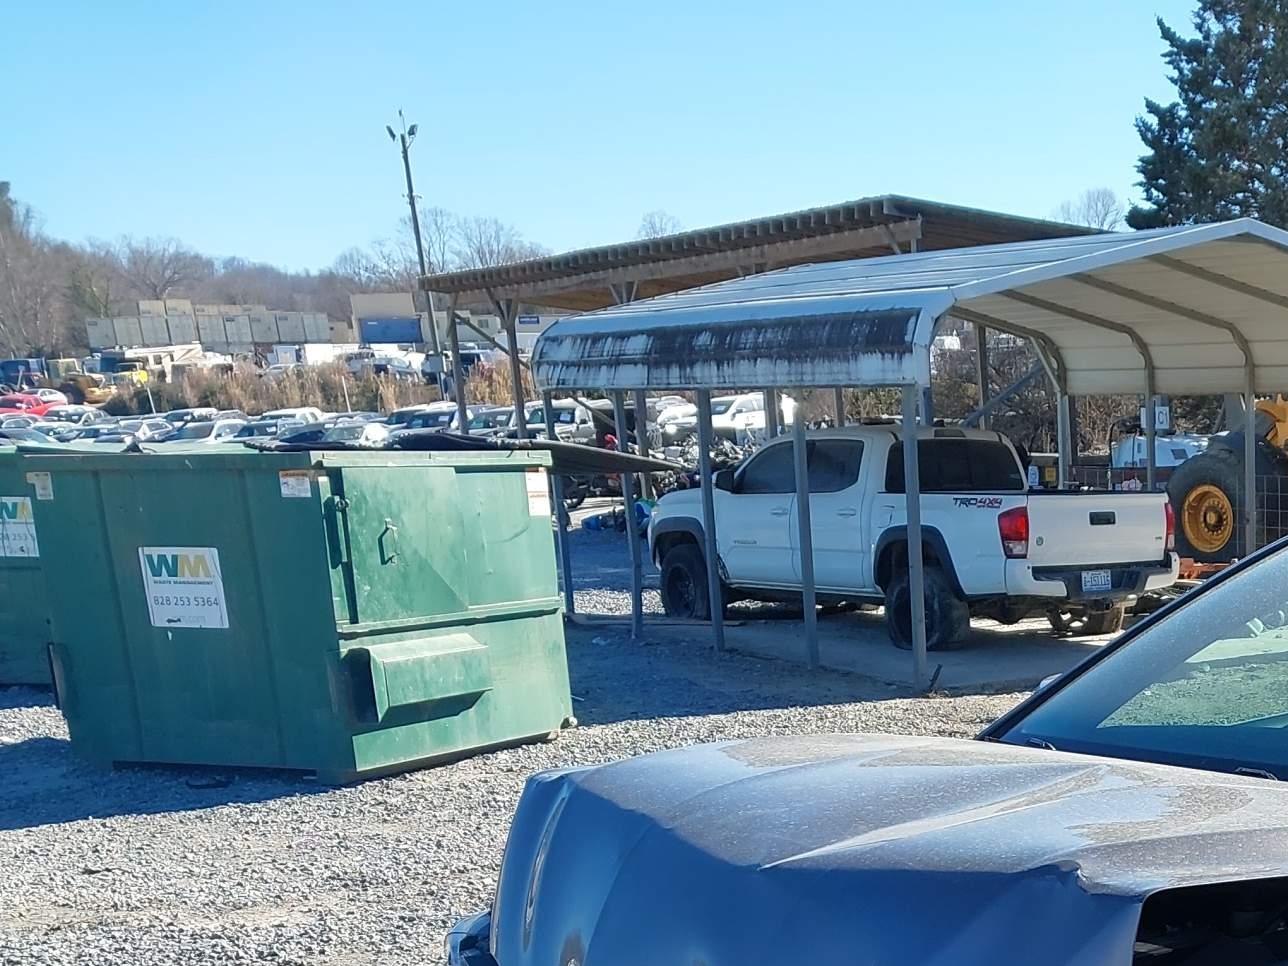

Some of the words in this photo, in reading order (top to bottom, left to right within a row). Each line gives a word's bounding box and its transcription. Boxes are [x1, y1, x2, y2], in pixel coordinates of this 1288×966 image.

[144, 554, 212, 577] WM
[153, 595, 171, 606] 828
[174, 595, 191, 607] 253
[194, 596, 219, 607] 5364
